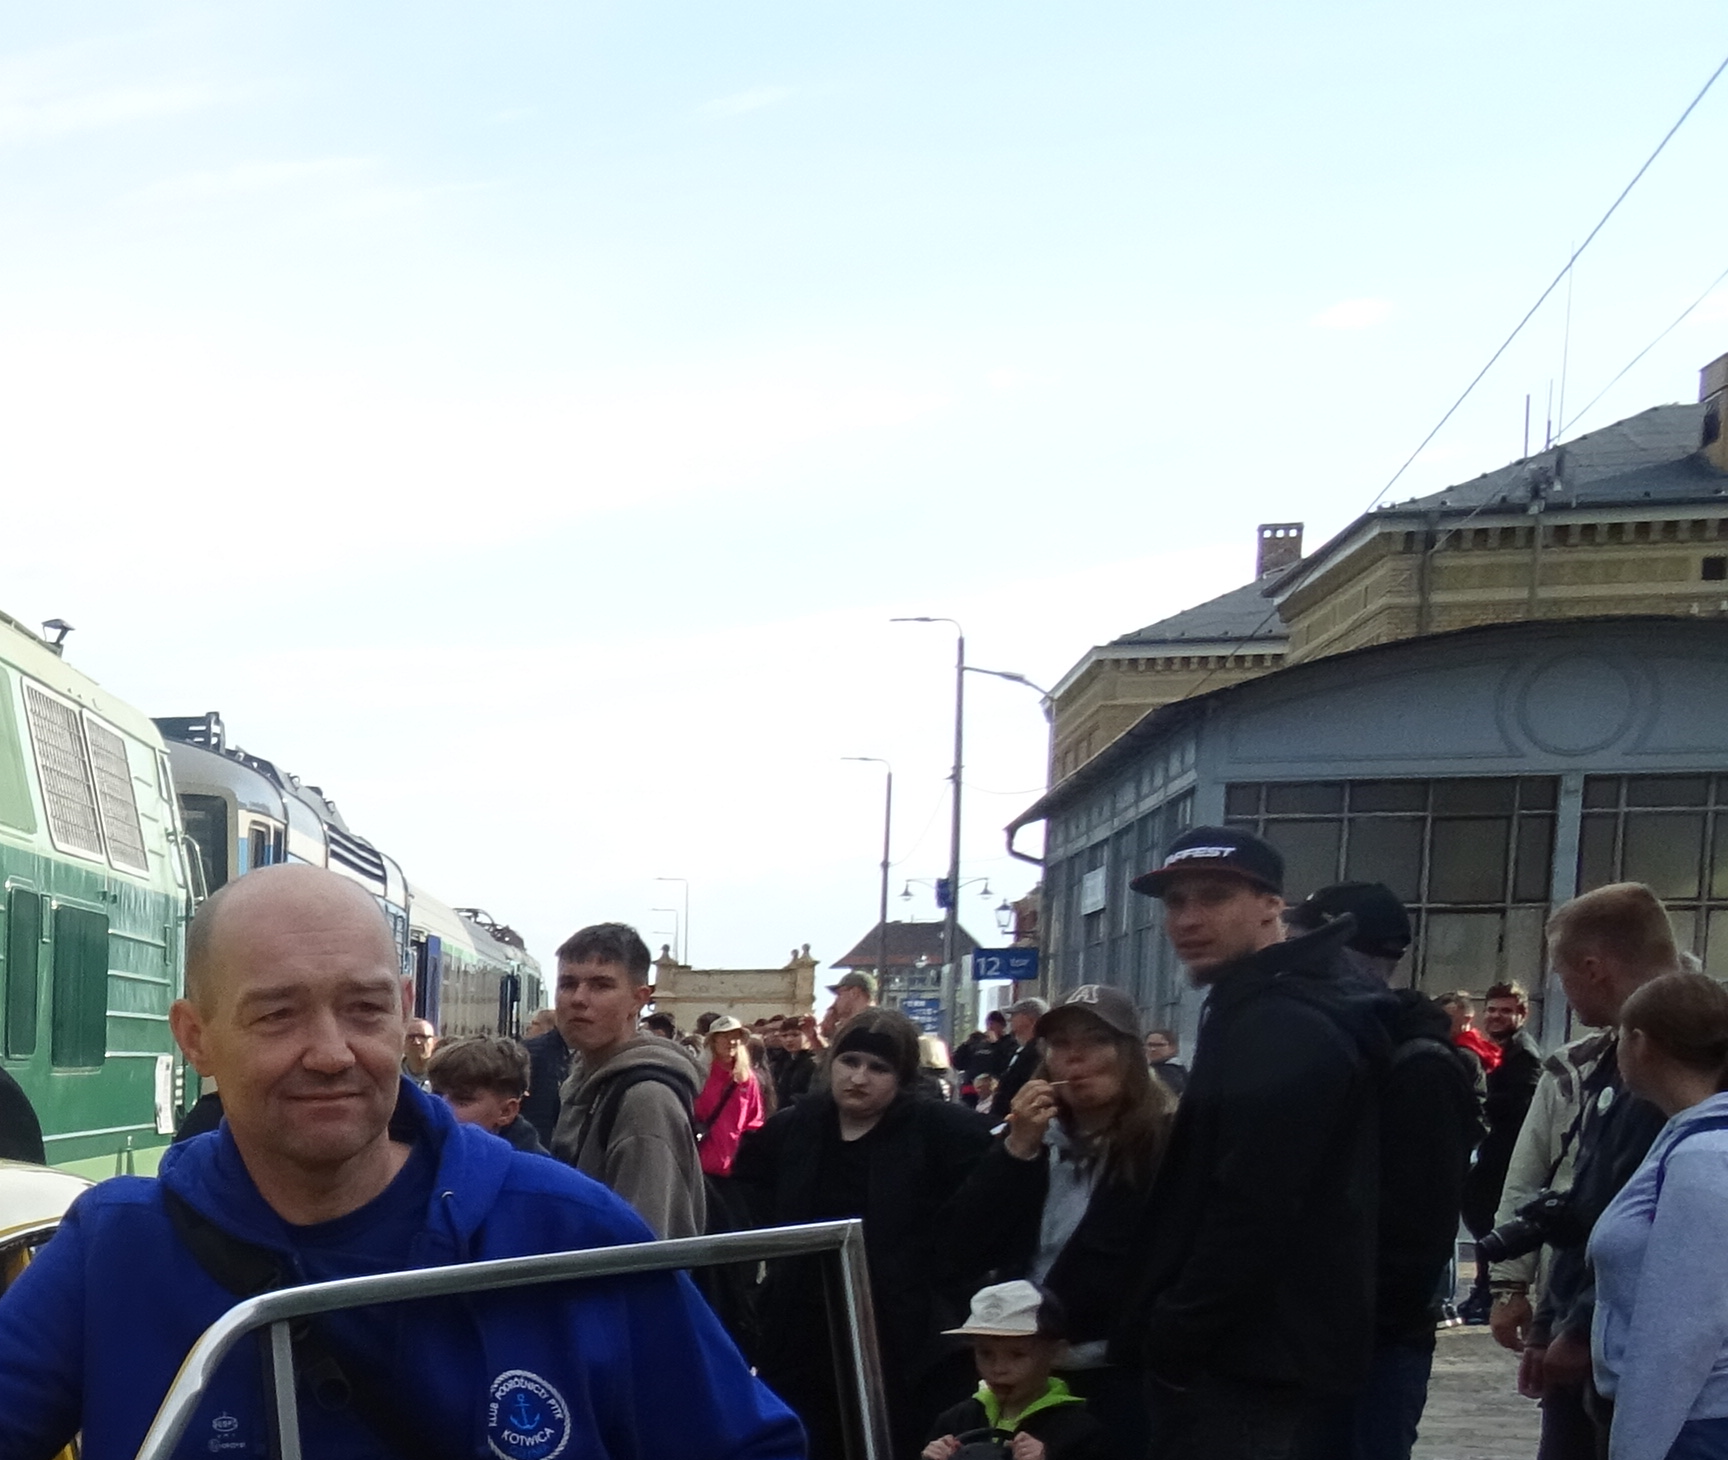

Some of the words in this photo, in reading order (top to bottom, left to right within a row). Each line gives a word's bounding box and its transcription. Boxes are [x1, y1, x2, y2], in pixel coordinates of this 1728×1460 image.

[976, 957, 1001, 976] 12
[546, 1398, 564, 1420] PTTK
[501, 1427, 556, 1447] KOTWICA
